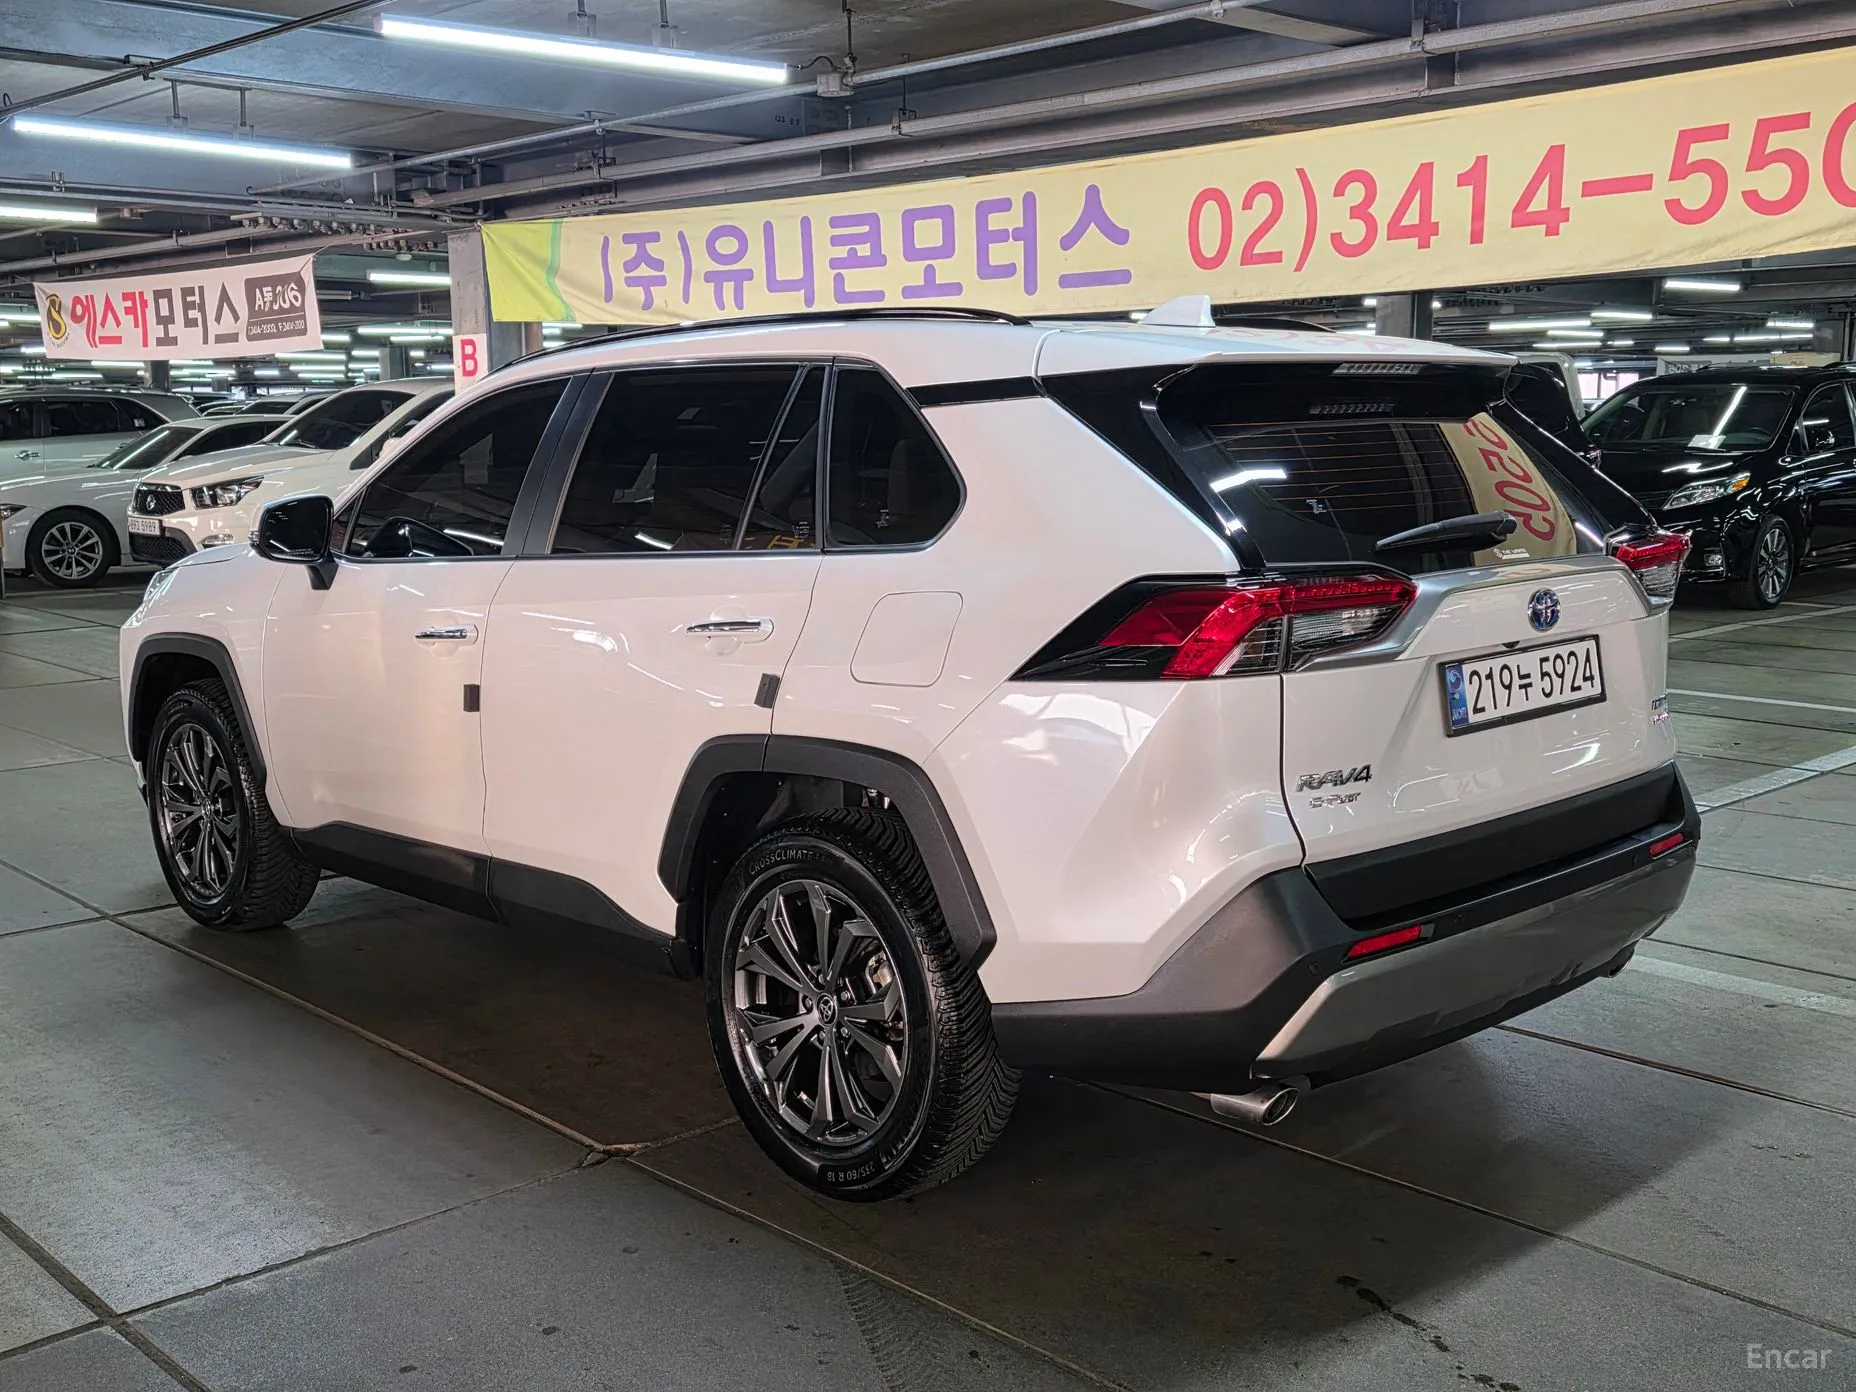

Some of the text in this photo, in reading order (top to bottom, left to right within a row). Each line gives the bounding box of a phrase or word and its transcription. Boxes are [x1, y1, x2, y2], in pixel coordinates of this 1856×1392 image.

[460, 339, 478, 377] B
[1468, 647, 1595, 715] 219누 5924
[1296, 764, 1372, 792] RAV4
